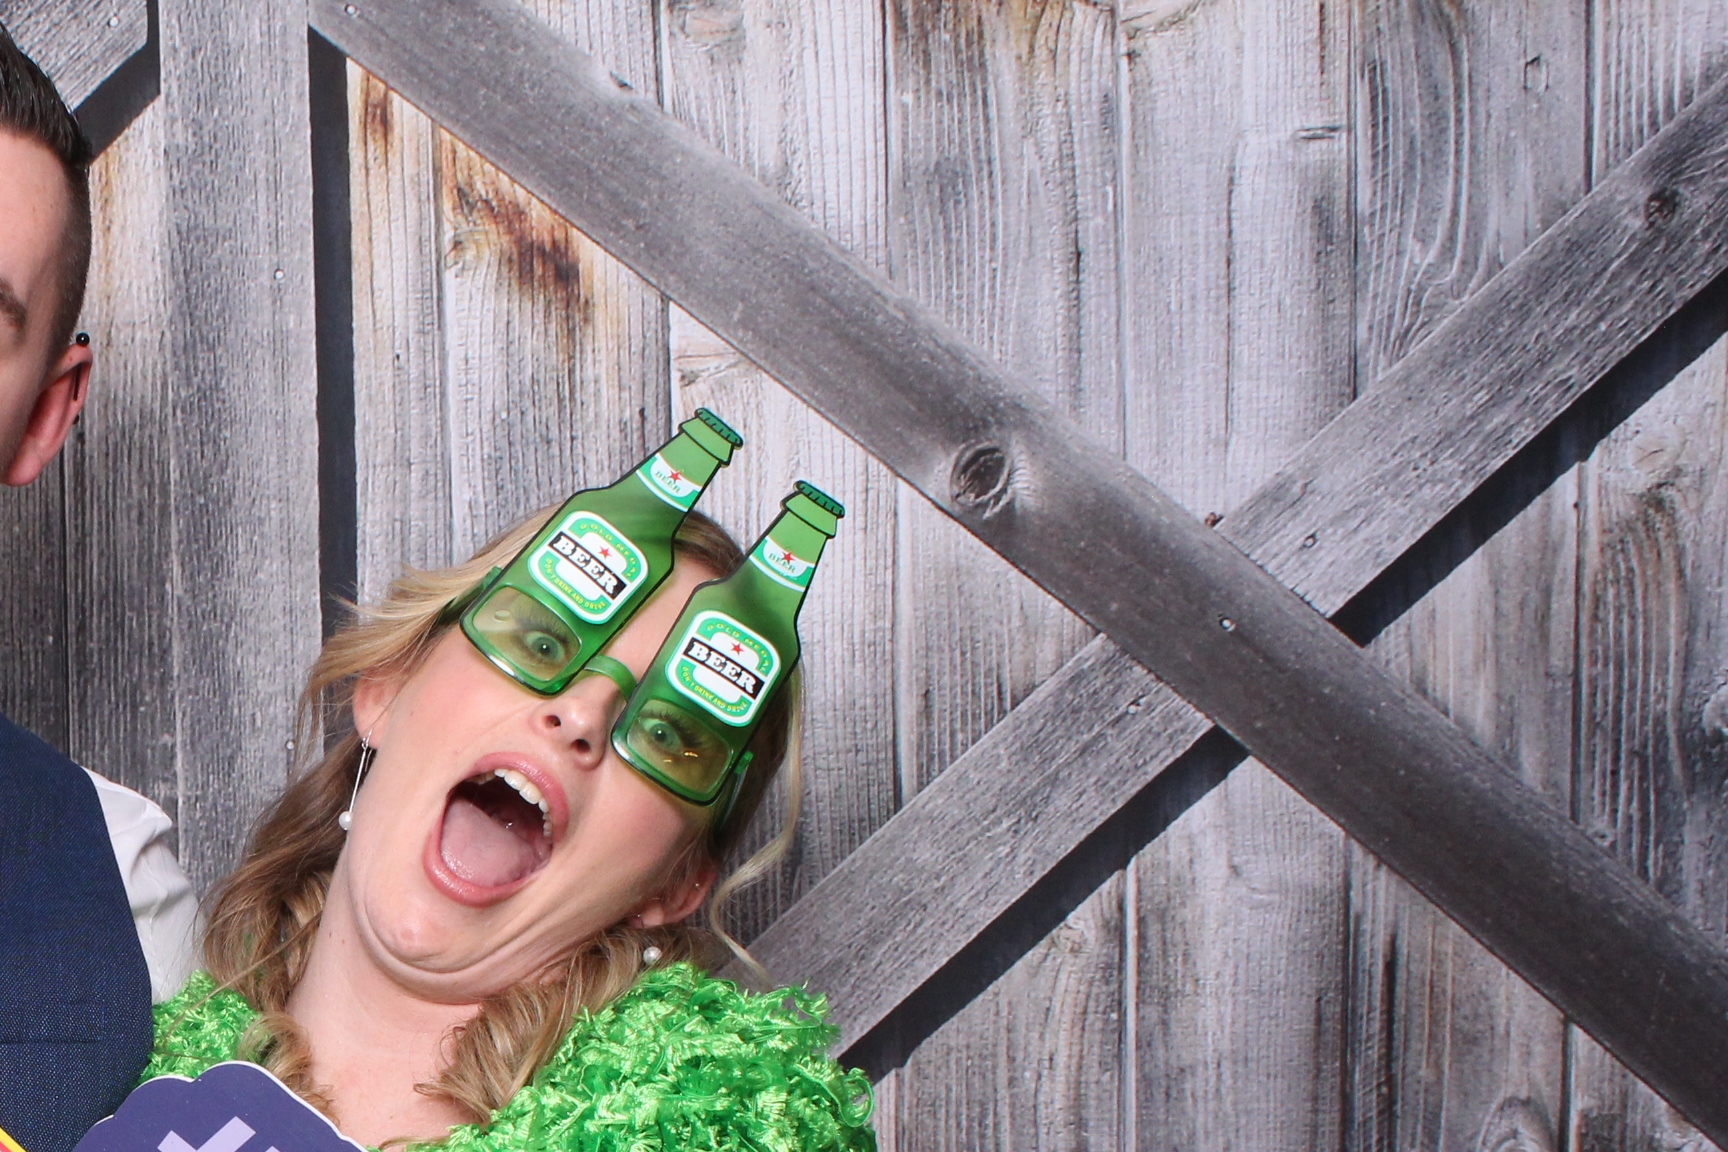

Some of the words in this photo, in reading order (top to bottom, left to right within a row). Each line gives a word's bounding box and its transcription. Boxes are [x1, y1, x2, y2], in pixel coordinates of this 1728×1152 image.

[655, 471, 681, 493] BEER
[552, 535, 618, 594] BEER
[768, 553, 796, 573] BEER
[554, 577, 573, 595] DRINK
[571, 592, 584, 604] AND
[584, 601, 606, 610] DRIVE
[687, 641, 757, 694] BEER
[694, 685, 714, 700] DRINK
[712, 697, 726, 709] AND
[726, 702, 748, 712] DRIVE
